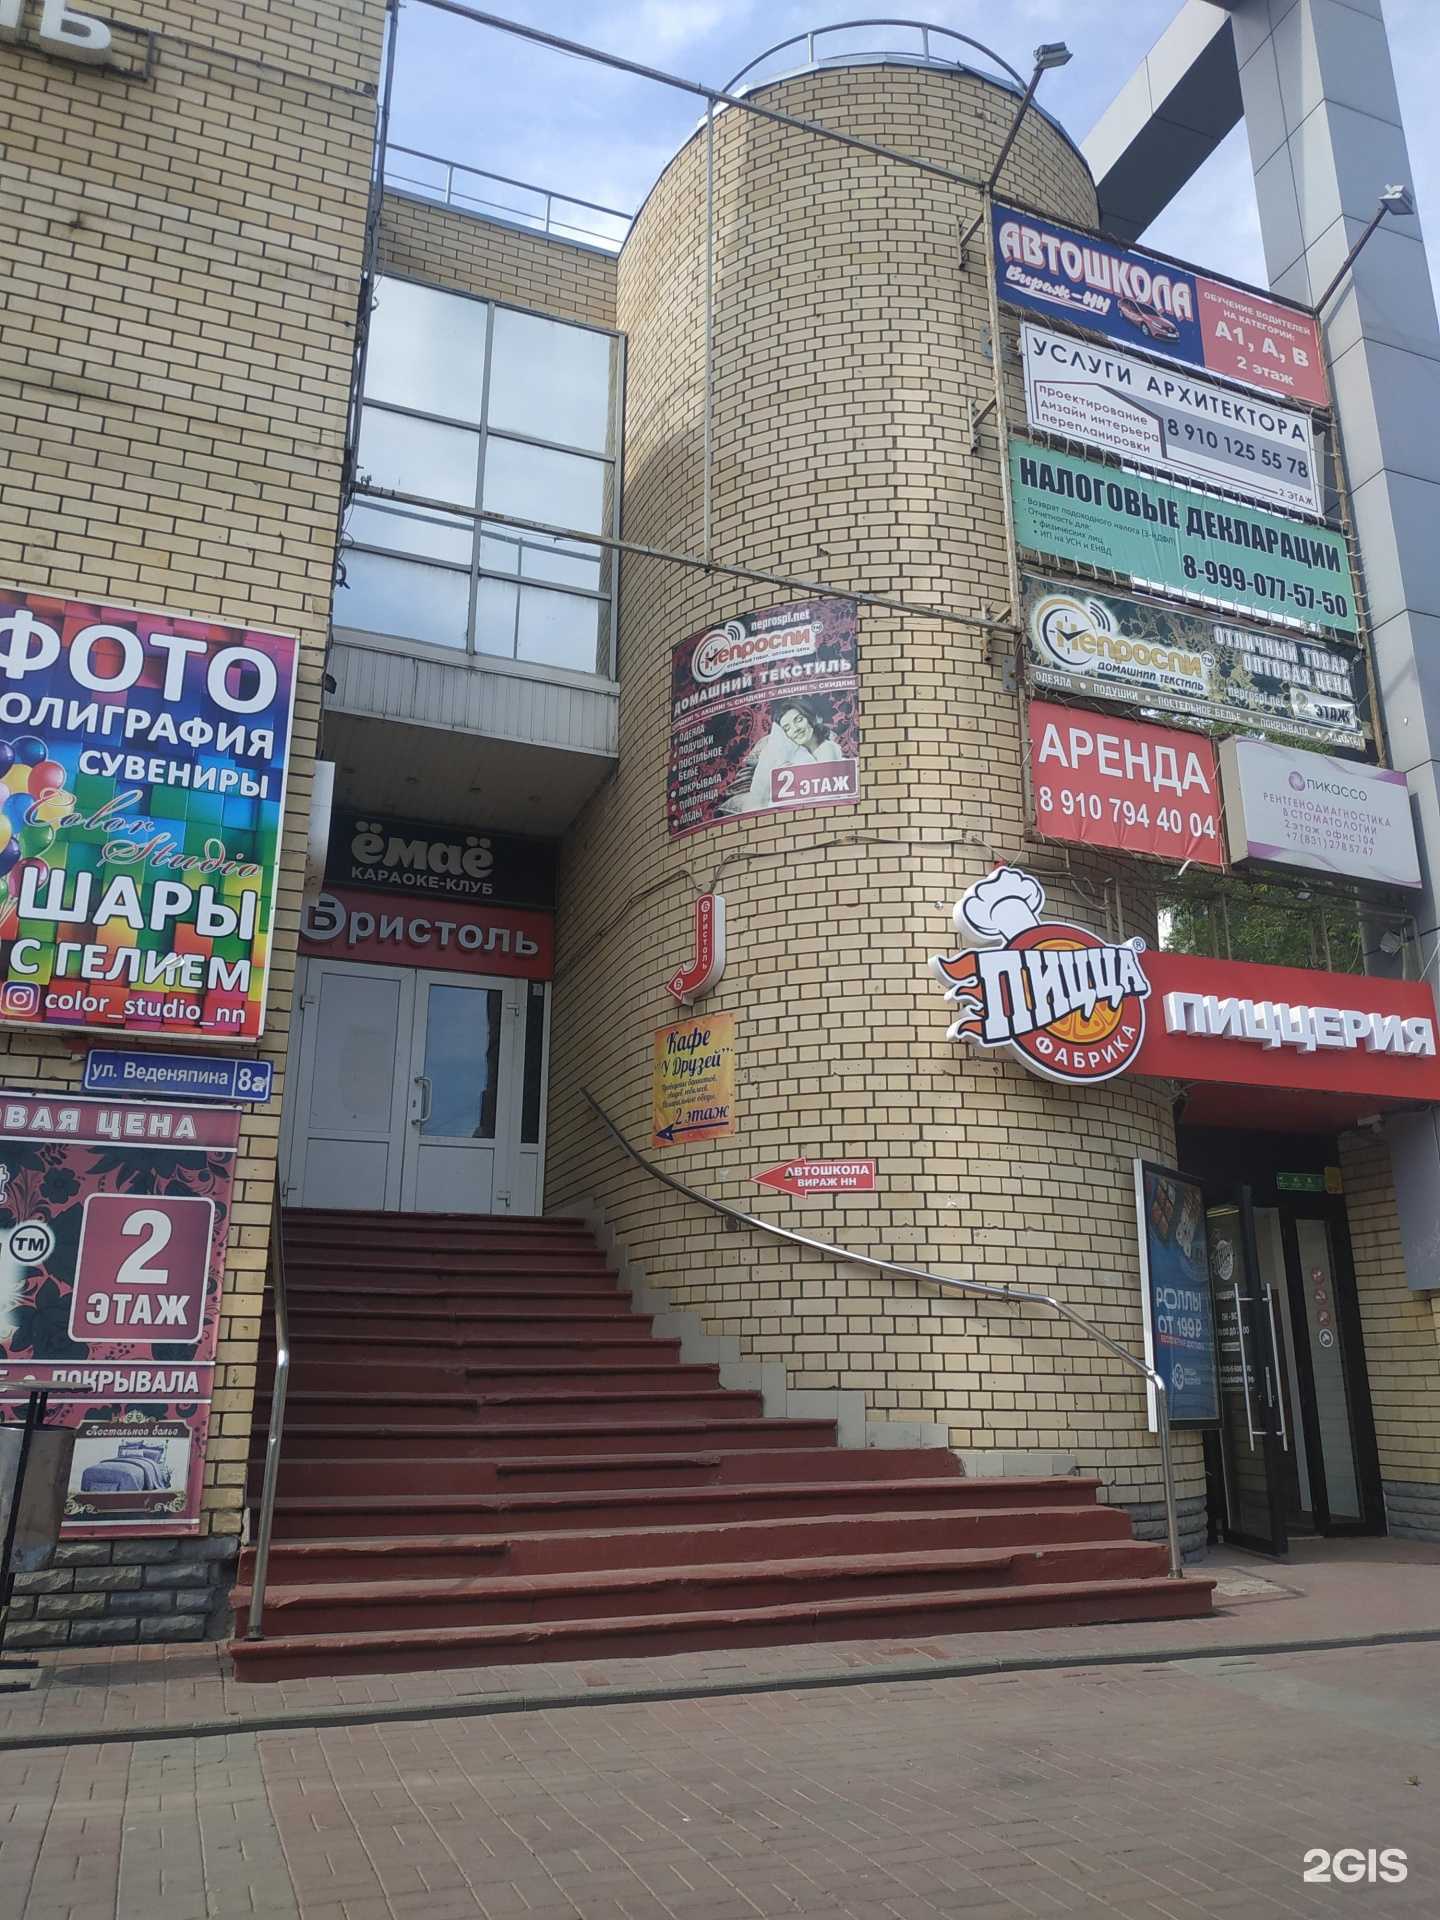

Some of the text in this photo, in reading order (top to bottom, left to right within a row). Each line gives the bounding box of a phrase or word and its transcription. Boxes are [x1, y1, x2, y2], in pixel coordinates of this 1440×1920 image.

[999, 221, 1193, 322] АВТОШКОЛА
[1204, 292, 1311, 336] ОБУЧЕНИЕ ВОДИТЕЛЕЙ
[1223, 310, 1237, 320] НА
[1033, 337, 1305, 442] УСЛУГИ АРХИТЕКТОРА
[1236, 356, 1295, 386] 2 этаж
[1040, 385, 1148, 425] проектирование
[1042, 413, 1151, 453] перепланировки
[1091, 414, 1160, 442] интерьера
[1167, 419, 1308, 479] 8 910 125 55 78
[1020, 457, 1341, 573] НАЛОГОВЫЕ ДЕКЛАРАЦИИ
[1279, 488, 1313, 506] 2 ЭТАЖ
[1183, 554, 1348, 618] 8-999-077-57-50
[750, 608, 810, 631] neprospi.net
[0, 608, 278, 714] ФОТО
[1213, 625, 1350, 674] ОТЛИЧНЫЙ ТОВАР
[673, 658, 852, 717] ДОМАШНИЙ ТЕКСТИЛЬ
[1035, 671, 1072, 689] ОДЕЯЛА
[1093, 683, 1138, 701] ПОДУШКИ
[1158, 695, 1213, 716] ПОСТЕЛЬНОЕ
[1159, 673, 1204, 691] ТЕКСТИЛЬ
[1242, 652, 1312, 686] ОПТОВАЯ
[1314, 670, 1354, 700] ЦЕНА
[1314, 703, 1351, 723] ЭТАЖ
[678, 746, 723, 770] ПОСТЕЛЬНОЕ
[679, 734, 714, 754] ПОДУШКИ
[1038, 723, 1210, 797] АРЕНДА
[78, 750, 269, 799] СУВЕНИРЫ
[678, 766, 699, 781] БЕЛЬЕ
[678, 773, 722, 796] ПОКРЫВАЛА
[777, 770, 849, 798] 2 ЭТАЖ
[22, 787, 155, 833] Color
[1039, 786, 1216, 840] 8 910 794 40 04
[1263, 792, 1392, 827] РЕНТГЕНОДИАГНОСТИКА
[1291, 809, 1377, 835] СТОМАТОЛОГИИ
[96, 829, 261, 877] Studio
[1325, 830, 1355, 843] офис
[351, 866, 493, 895] КАРАОКЕ-КЛУБ
[17, 865, 257, 941] ШАРЫ
[300, 892, 539, 955] Бристоль
[10, 938, 250, 993] С ГЕЛИЕМ
[44, 989, 246, 1026] color_studio_nn
[976, 947, 1148, 1044] ПИЦЦА
[667, 1027, 711, 1055] Кафе
[1165, 991, 1436, 1056] ПИЦЦЕРИЯ
[1035, 1024, 1137, 1069] ФАБРИКА
[91, 1062, 117, 1080] ул.
[123, 1062, 229, 1085] Веденяпина
[0, 1104, 196, 1140] ВАЯ ЦЕНА
[673, 1105, 730, 1124] 2 этаж
[784, 1165, 870, 1177] АВТОШКОЛА
[797, 1177, 857, 1187] ВИРАЖ НН
[116, 1209, 172, 1285] 2
[85, 1292, 191, 1326] ЭТАЖ
[1156, 1287, 1202, 1313] РОЛЛЫ
[1157, 1314, 1174, 1334] ОТ
